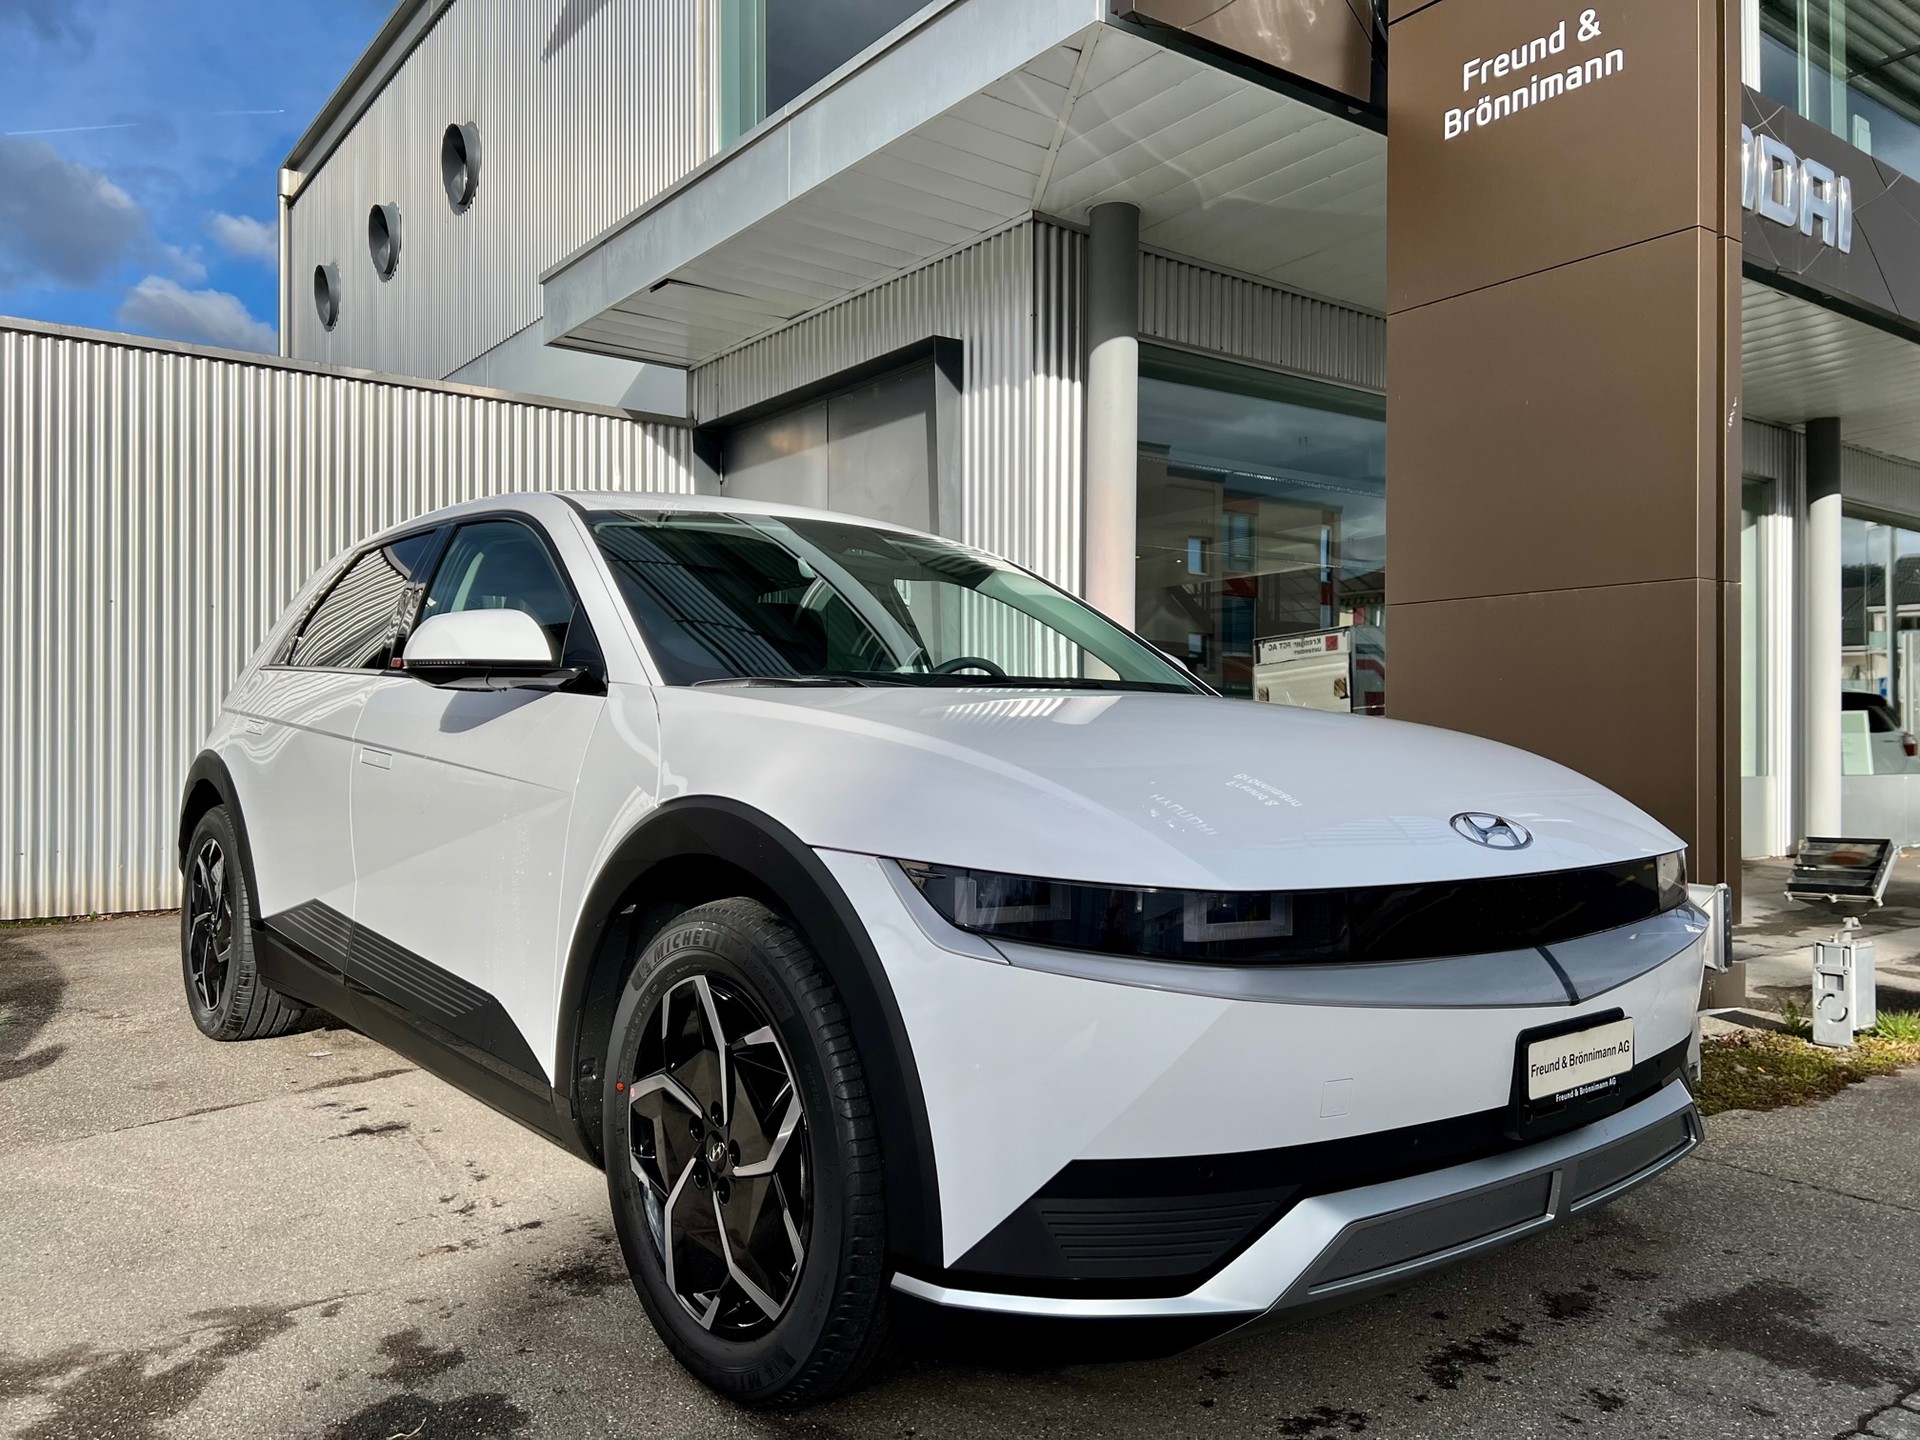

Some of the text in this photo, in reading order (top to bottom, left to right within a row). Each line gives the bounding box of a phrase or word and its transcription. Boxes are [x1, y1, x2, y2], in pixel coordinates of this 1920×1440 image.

[1463, 8, 1602, 91] Freund &
[1444, 48, 1624, 140] Brönnimann
[653, 930, 733, 962] MICHELIN
[1531, 1040, 1630, 1078] Freund & Brönnimann AG
[1556, 1089, 1573, 1102] Freund
[1609, 1077, 1616, 1086] AG
